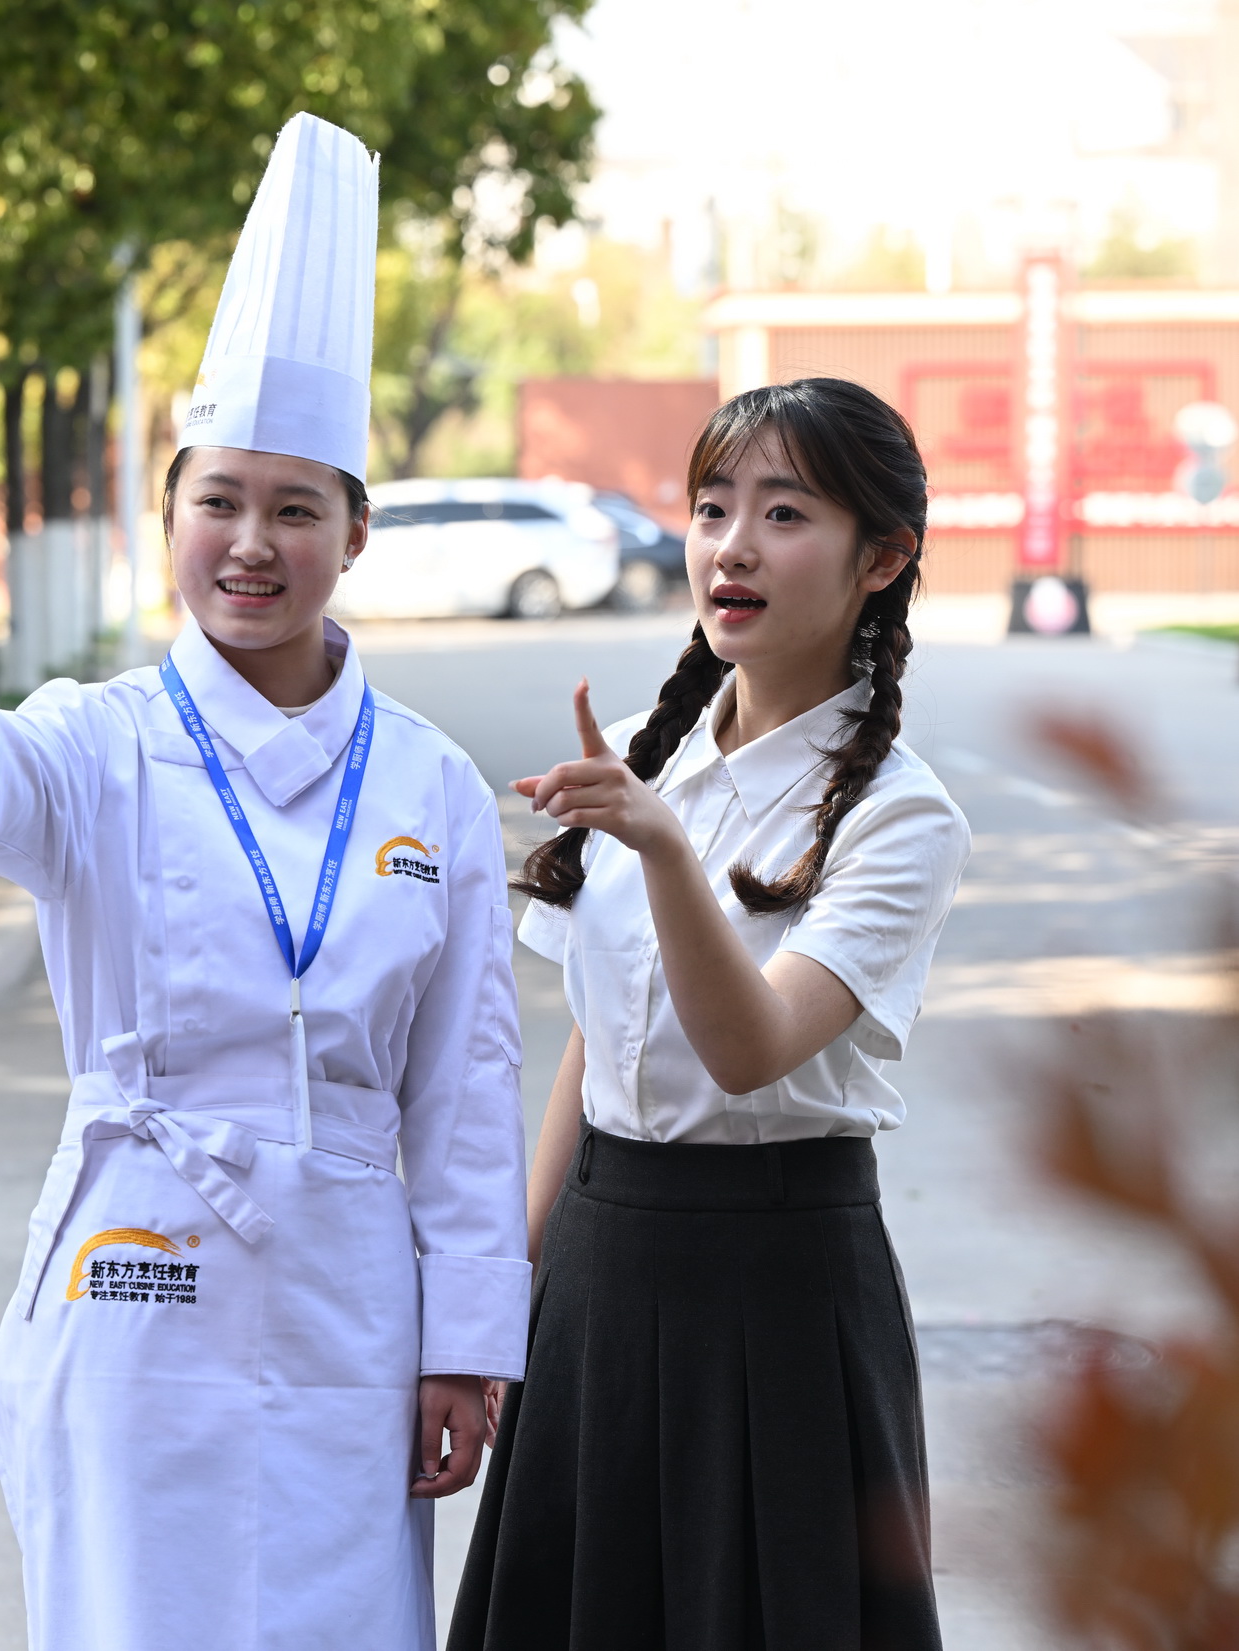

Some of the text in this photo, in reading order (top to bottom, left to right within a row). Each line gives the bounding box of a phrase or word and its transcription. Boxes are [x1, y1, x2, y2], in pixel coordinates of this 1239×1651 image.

[195, 733, 215, 758] 学厨师
[349, 706, 372, 770] 学厨师 新东方烹饪
[220, 788, 239, 821] NEW EAST
[335, 798, 349, 830] NEW EAST
[250, 849, 285, 926] 学厨师 新东方烹饪
[312, 858, 338, 931] 学厨师 新东方烹饪
[90, 1259, 200, 1282] 新东方烹饪教育
[90, 1280, 196, 1293] NEW EAST CUISINE EDUCATION
[90, 1290, 197, 1304] 专注烹饪教育 始于1988
